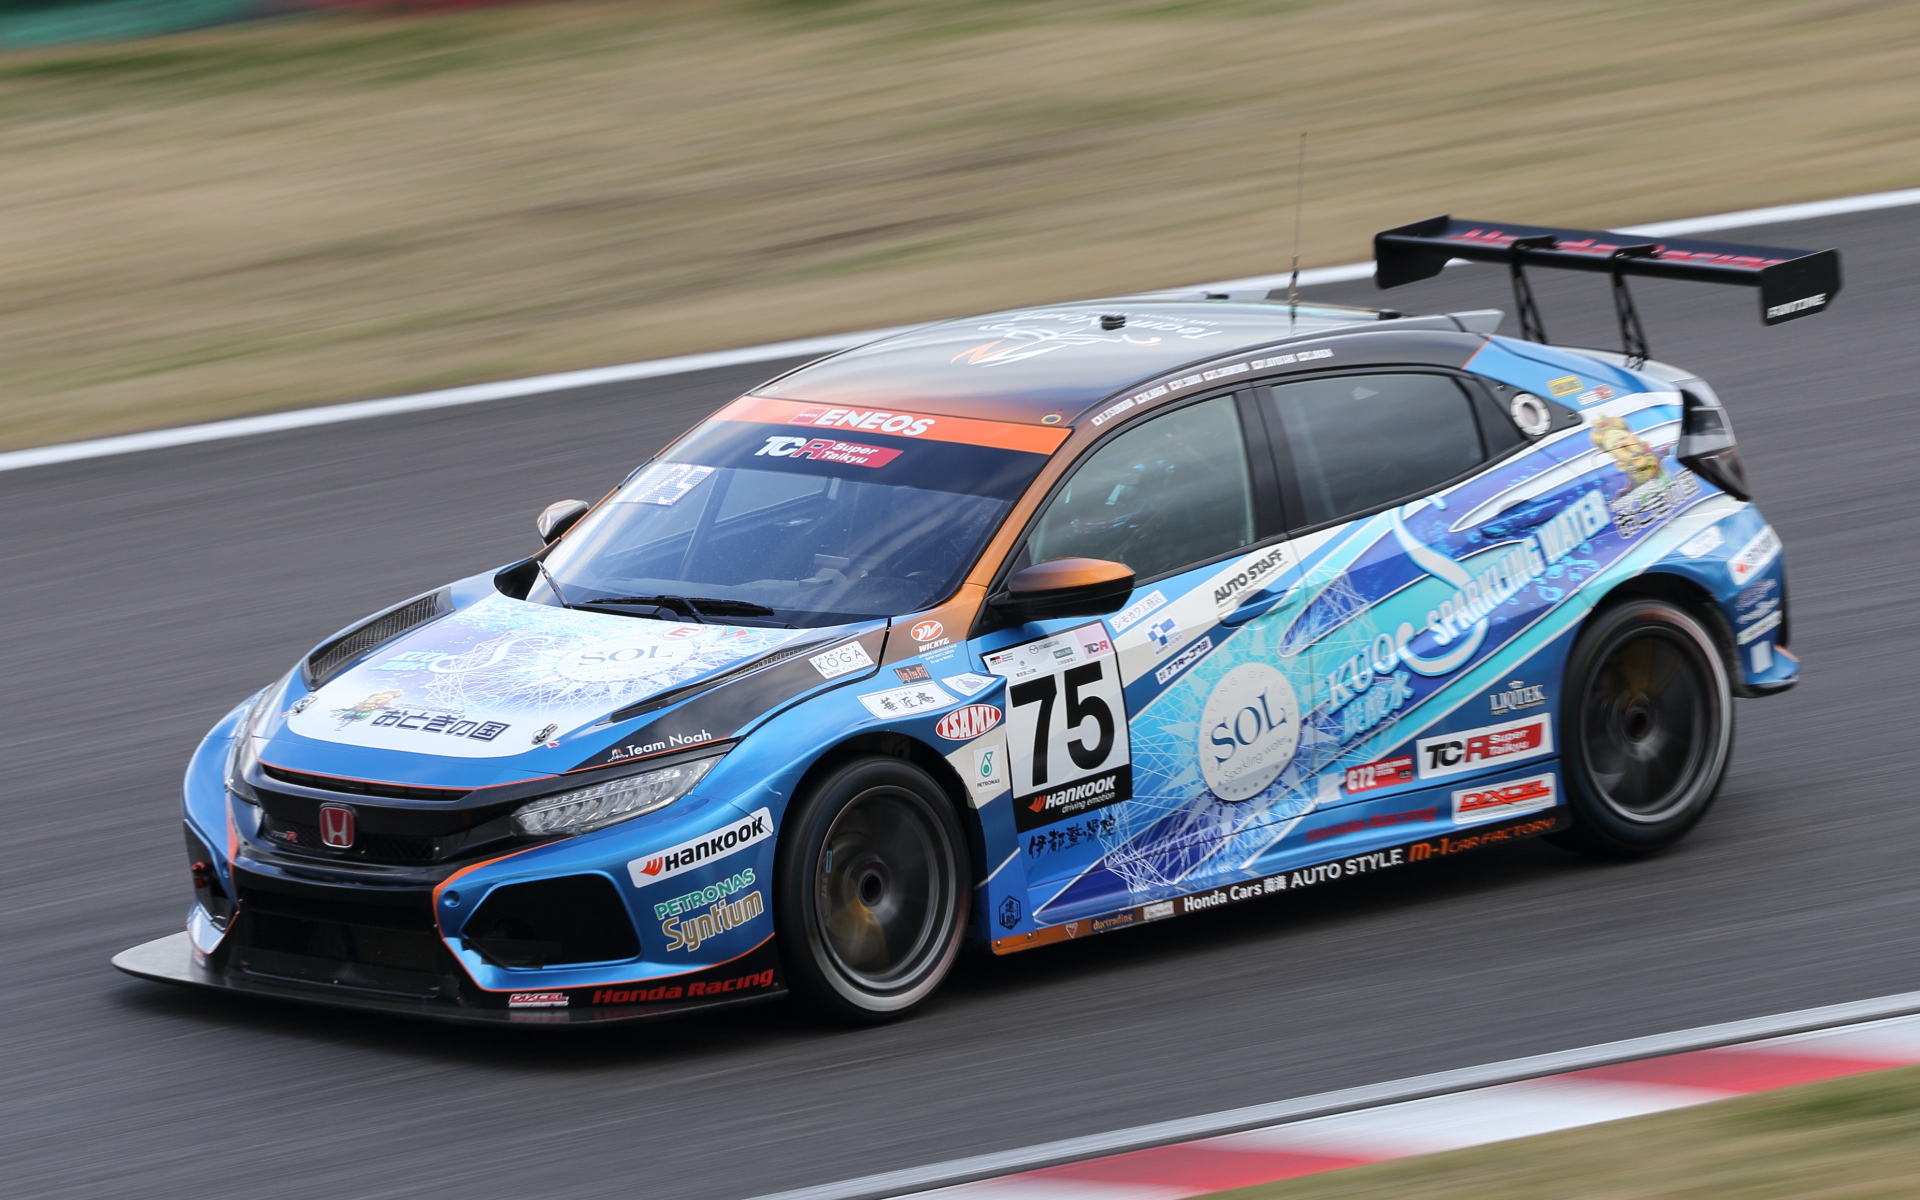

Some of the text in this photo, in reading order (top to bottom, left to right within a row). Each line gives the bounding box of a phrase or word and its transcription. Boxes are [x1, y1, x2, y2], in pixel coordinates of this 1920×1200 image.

[815, 408, 935, 436] ENEOS
[754, 435, 836, 460] TCR
[821, 450, 869, 464] Taikyu
[832, 442, 879, 456] Super
[1213, 573, 1248, 605] AUTO
[1248, 548, 1283, 580] STAFF
[1427, 534, 1547, 647] SPARKLING
[1536, 488, 1613, 567] WATER
[577, 644, 674, 668] SOL
[918, 637, 950, 653] WICKYZ
[1084, 639, 1109, 656] TCR
[816, 651, 866, 672] KOGA
[370, 709, 512, 743] おとぎの国
[940, 705, 999, 738] ISAMU
[1009, 660, 1115, 787] 75
[1210, 685, 1289, 772] SOL
[1487, 728, 1530, 744] Super
[624, 729, 713, 759] Team Noah
[1424, 733, 1490, 769] TCR
[976, 777, 1001, 789] PETRONAS
[1060, 797, 1086, 814] driving
[653, 867, 756, 920] PETRONAS
[1184, 891, 1228, 913] Honda
[1229, 884, 1263, 905] Cars
[1290, 861, 1342, 889] AUTO
[1344, 848, 1404, 876] STYLE
[662, 890, 765, 953] Syntium
[592, 968, 775, 1004] Honda Racing
